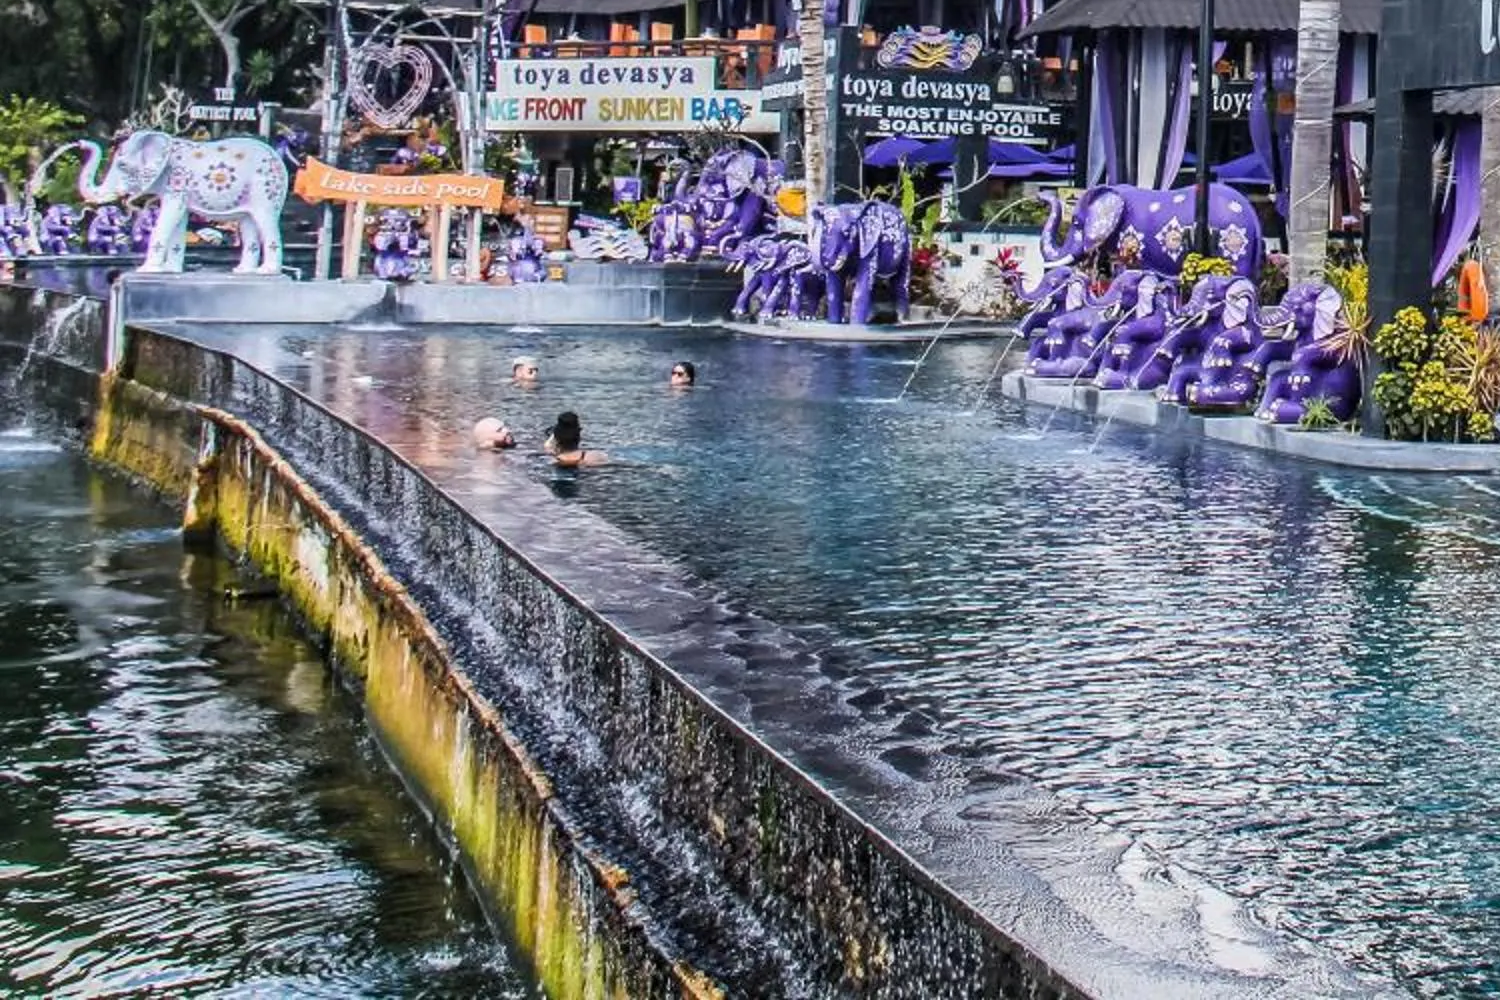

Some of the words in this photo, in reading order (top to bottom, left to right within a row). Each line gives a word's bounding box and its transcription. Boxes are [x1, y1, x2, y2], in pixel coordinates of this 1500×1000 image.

[514, 63, 570, 90] toya
[579, 60, 694, 90] devasya
[842, 73, 893, 101] toya
[901, 75, 991, 106] devasya
[487, 98, 519, 121] AKE
[524, 97, 588, 121] FRONT
[599, 97, 685, 121] SUNKEN
[691, 98, 742, 121] BAR
[842, 102, 882, 118] THE
[887, 105, 944, 121] MOST
[947, 108, 1061, 126] ENJOYABLE
[878, 119, 974, 135] SOAKING
[981, 122, 1034, 137] POOL
[320, 171, 375, 194] Lake
[434, 182, 490, 200] pool
